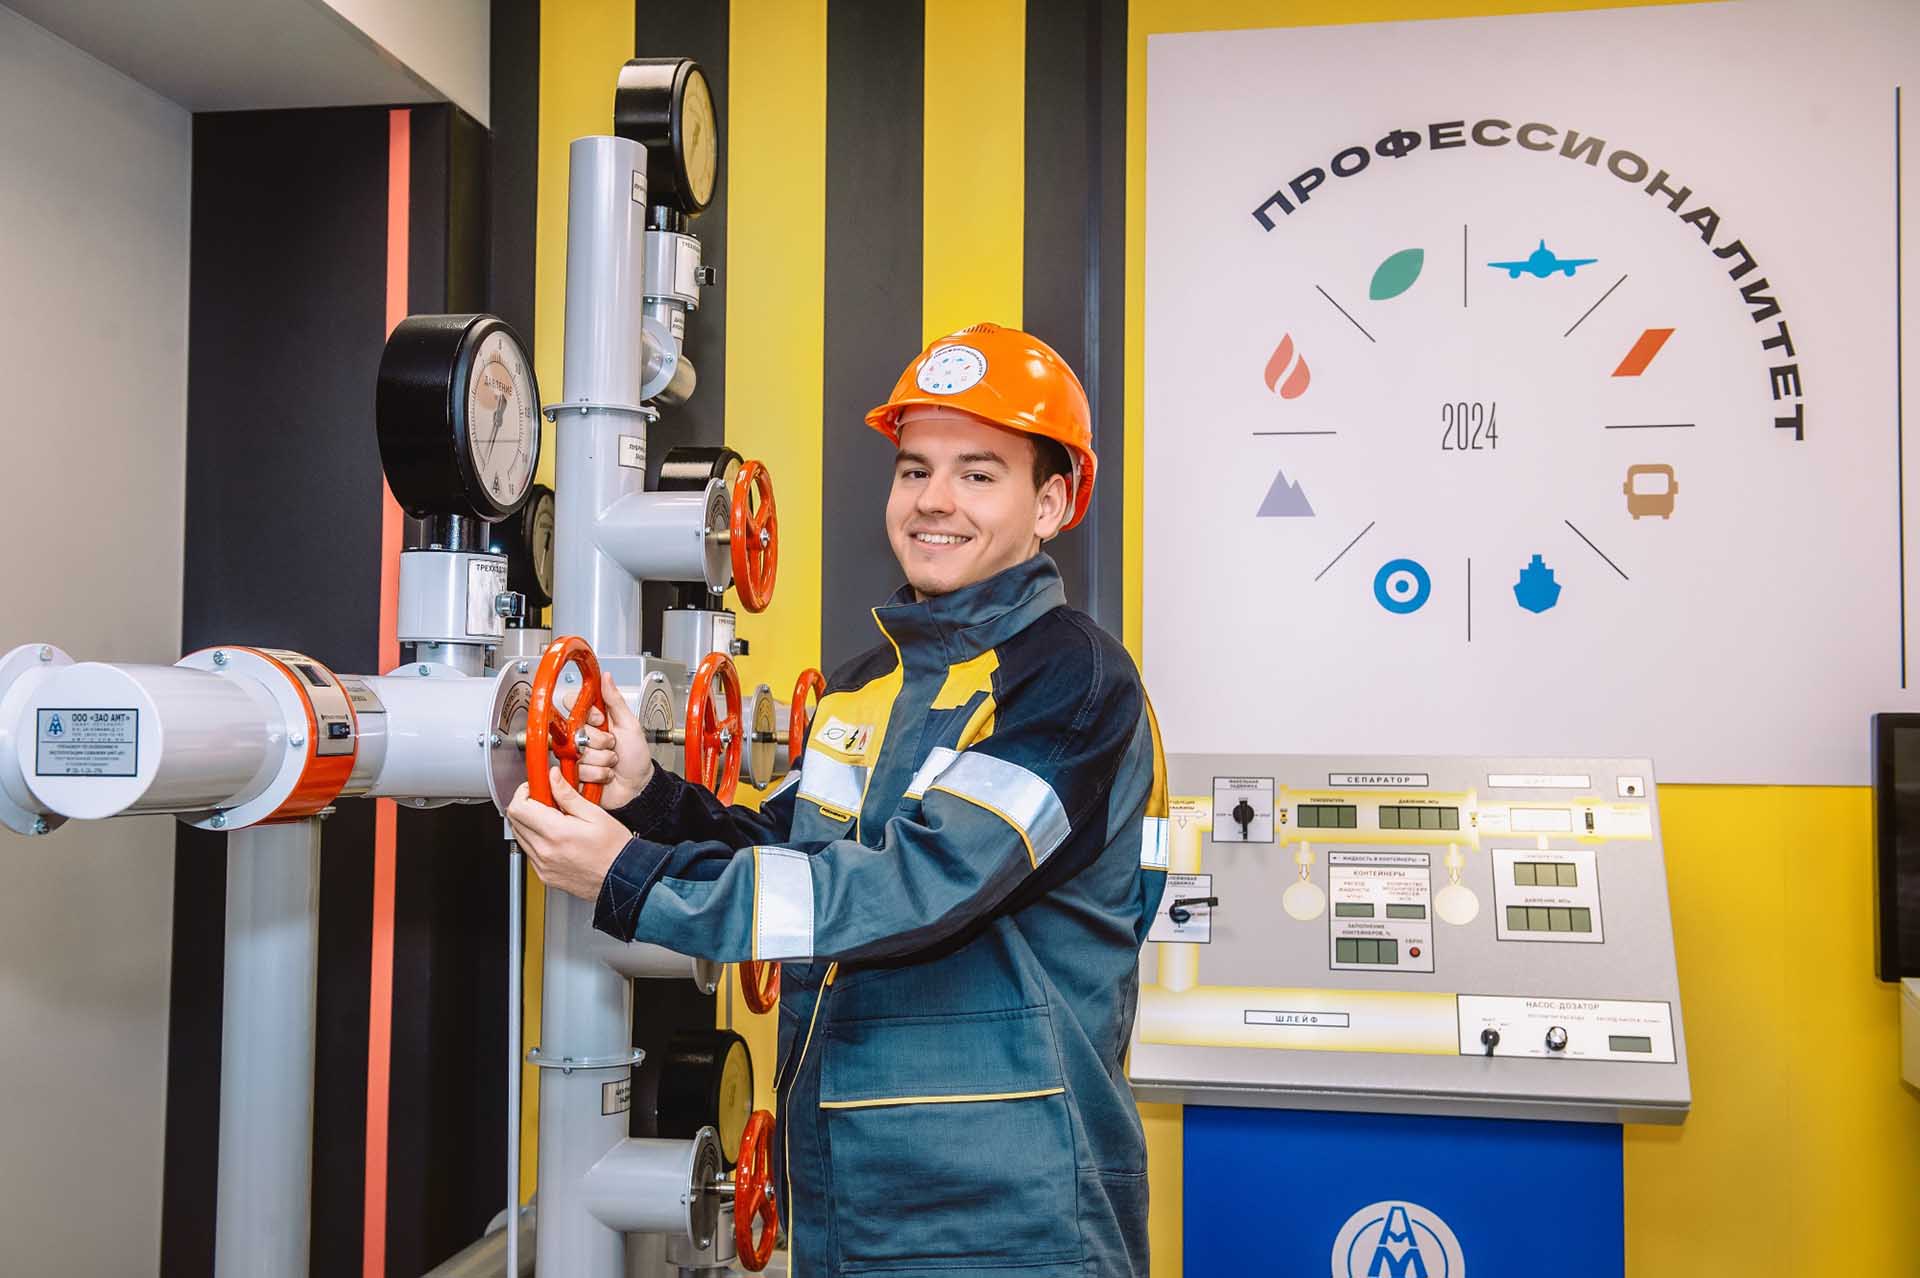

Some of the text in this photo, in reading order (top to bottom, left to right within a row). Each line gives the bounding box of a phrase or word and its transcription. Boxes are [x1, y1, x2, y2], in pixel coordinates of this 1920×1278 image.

[1252, 118, 1804, 442] ПРОФЕССИОНАЛИТЕТ
[483, 375, 513, 396] ДАВЛЕНИЕ
[1441, 401, 1499, 452] 2024
[71, 713, 88, 722] ООО
[1347, 776, 1411, 784] СЕПАРАТОР
[1275, 1014, 1319, 1024] ШЛЕЙФ
